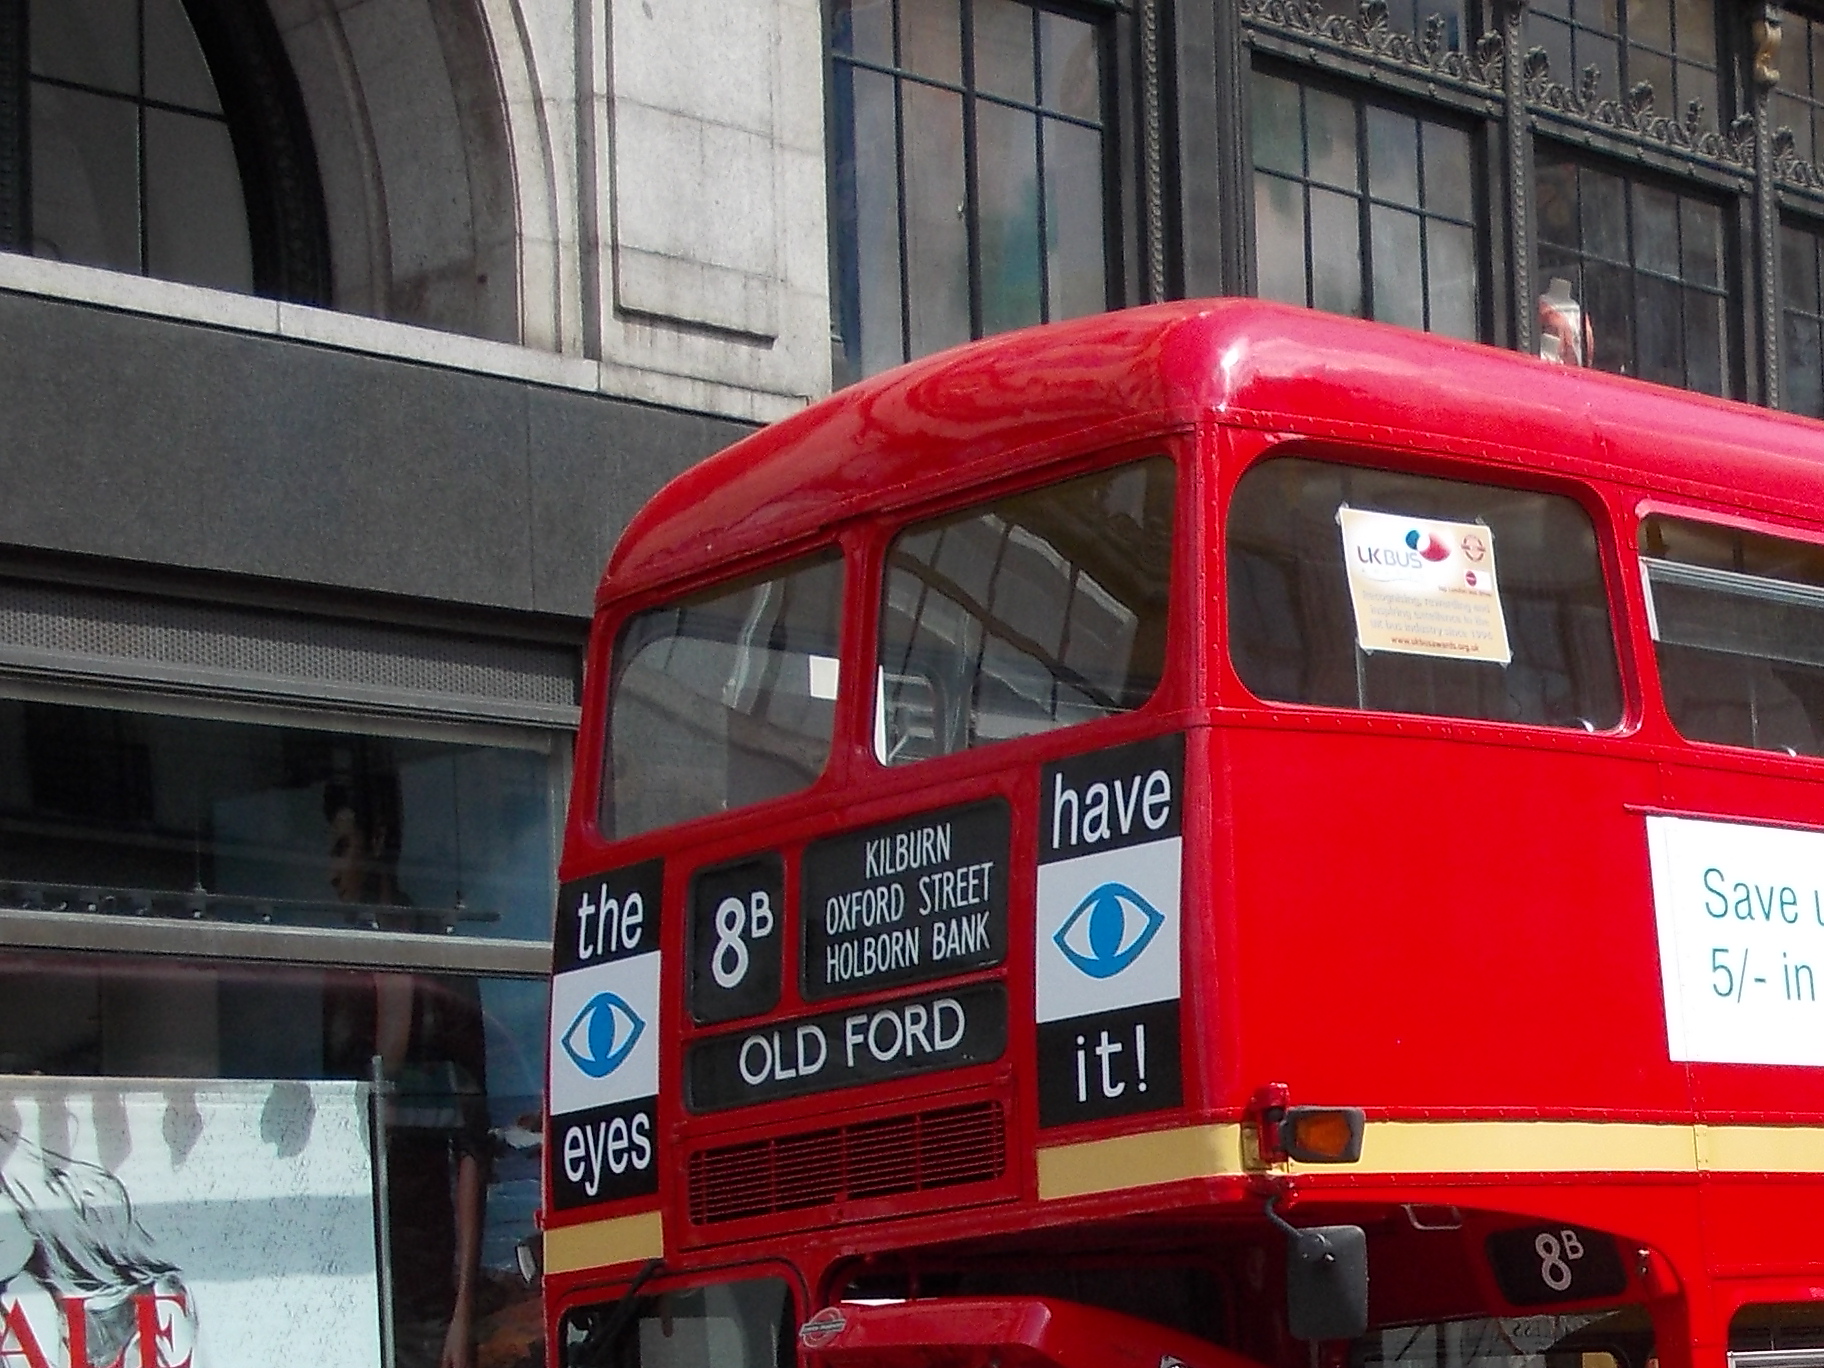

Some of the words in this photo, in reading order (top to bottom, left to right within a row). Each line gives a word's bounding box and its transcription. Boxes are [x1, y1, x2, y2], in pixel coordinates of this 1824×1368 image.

[1050, 769, 1171, 849] have
[865, 823, 951, 880] KILBURN
[578, 883, 644, 960] the
[826, 882, 904, 935] OXFORD
[919, 862, 994, 916] STREET
[1702, 867, 1798, 920] Save
[826, 927, 919, 984] HOLBORN
[933, 911, 990, 962] BANK
[1710, 947, 1766, 1004] 5/-
[1782, 951, 1815, 1003] in
[739, 1024, 827, 1086] OLD
[846, 997, 966, 1067] FORD
[1075, 1024, 1147, 1103] it!
[564, 1111, 651, 1197] eyes
